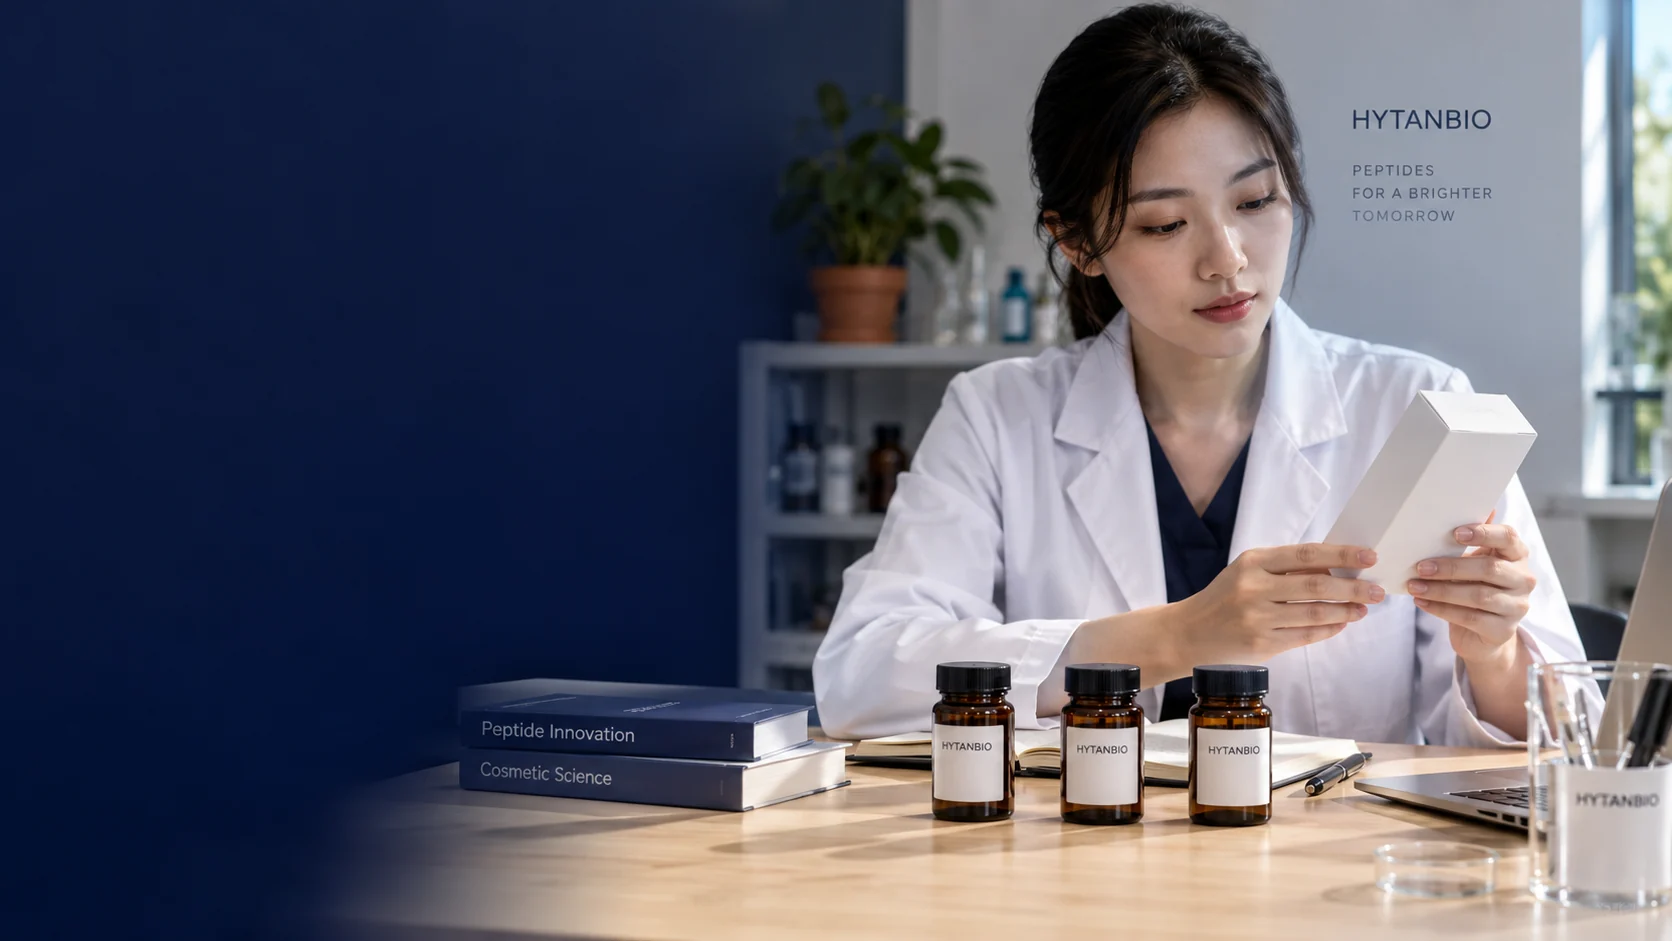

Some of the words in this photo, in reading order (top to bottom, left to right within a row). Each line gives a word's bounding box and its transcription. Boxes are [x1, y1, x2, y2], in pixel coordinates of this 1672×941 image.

[1352, 109, 1492, 130] HYTANBIO
[1352, 164, 1434, 177] PEPTIDES
[1352, 187, 1385, 199] FOR
[1391, 187, 1402, 199] A
[1409, 187, 1492, 199] BRIGHTER
[1352, 210, 1455, 222] TOMORROW
[481, 720, 545, 740] Peptide
[549, 723, 635, 743] Innovation
[941, 740, 992, 752] HYTANBIO
[1076, 744, 1128, 755] HYTANBIO
[1208, 745, 1260, 755] HYTANBIO
[480, 761, 550, 781] Cosmetic
[554, 766, 613, 786] Science
[1575, 791, 1661, 808] HYTANBIO
